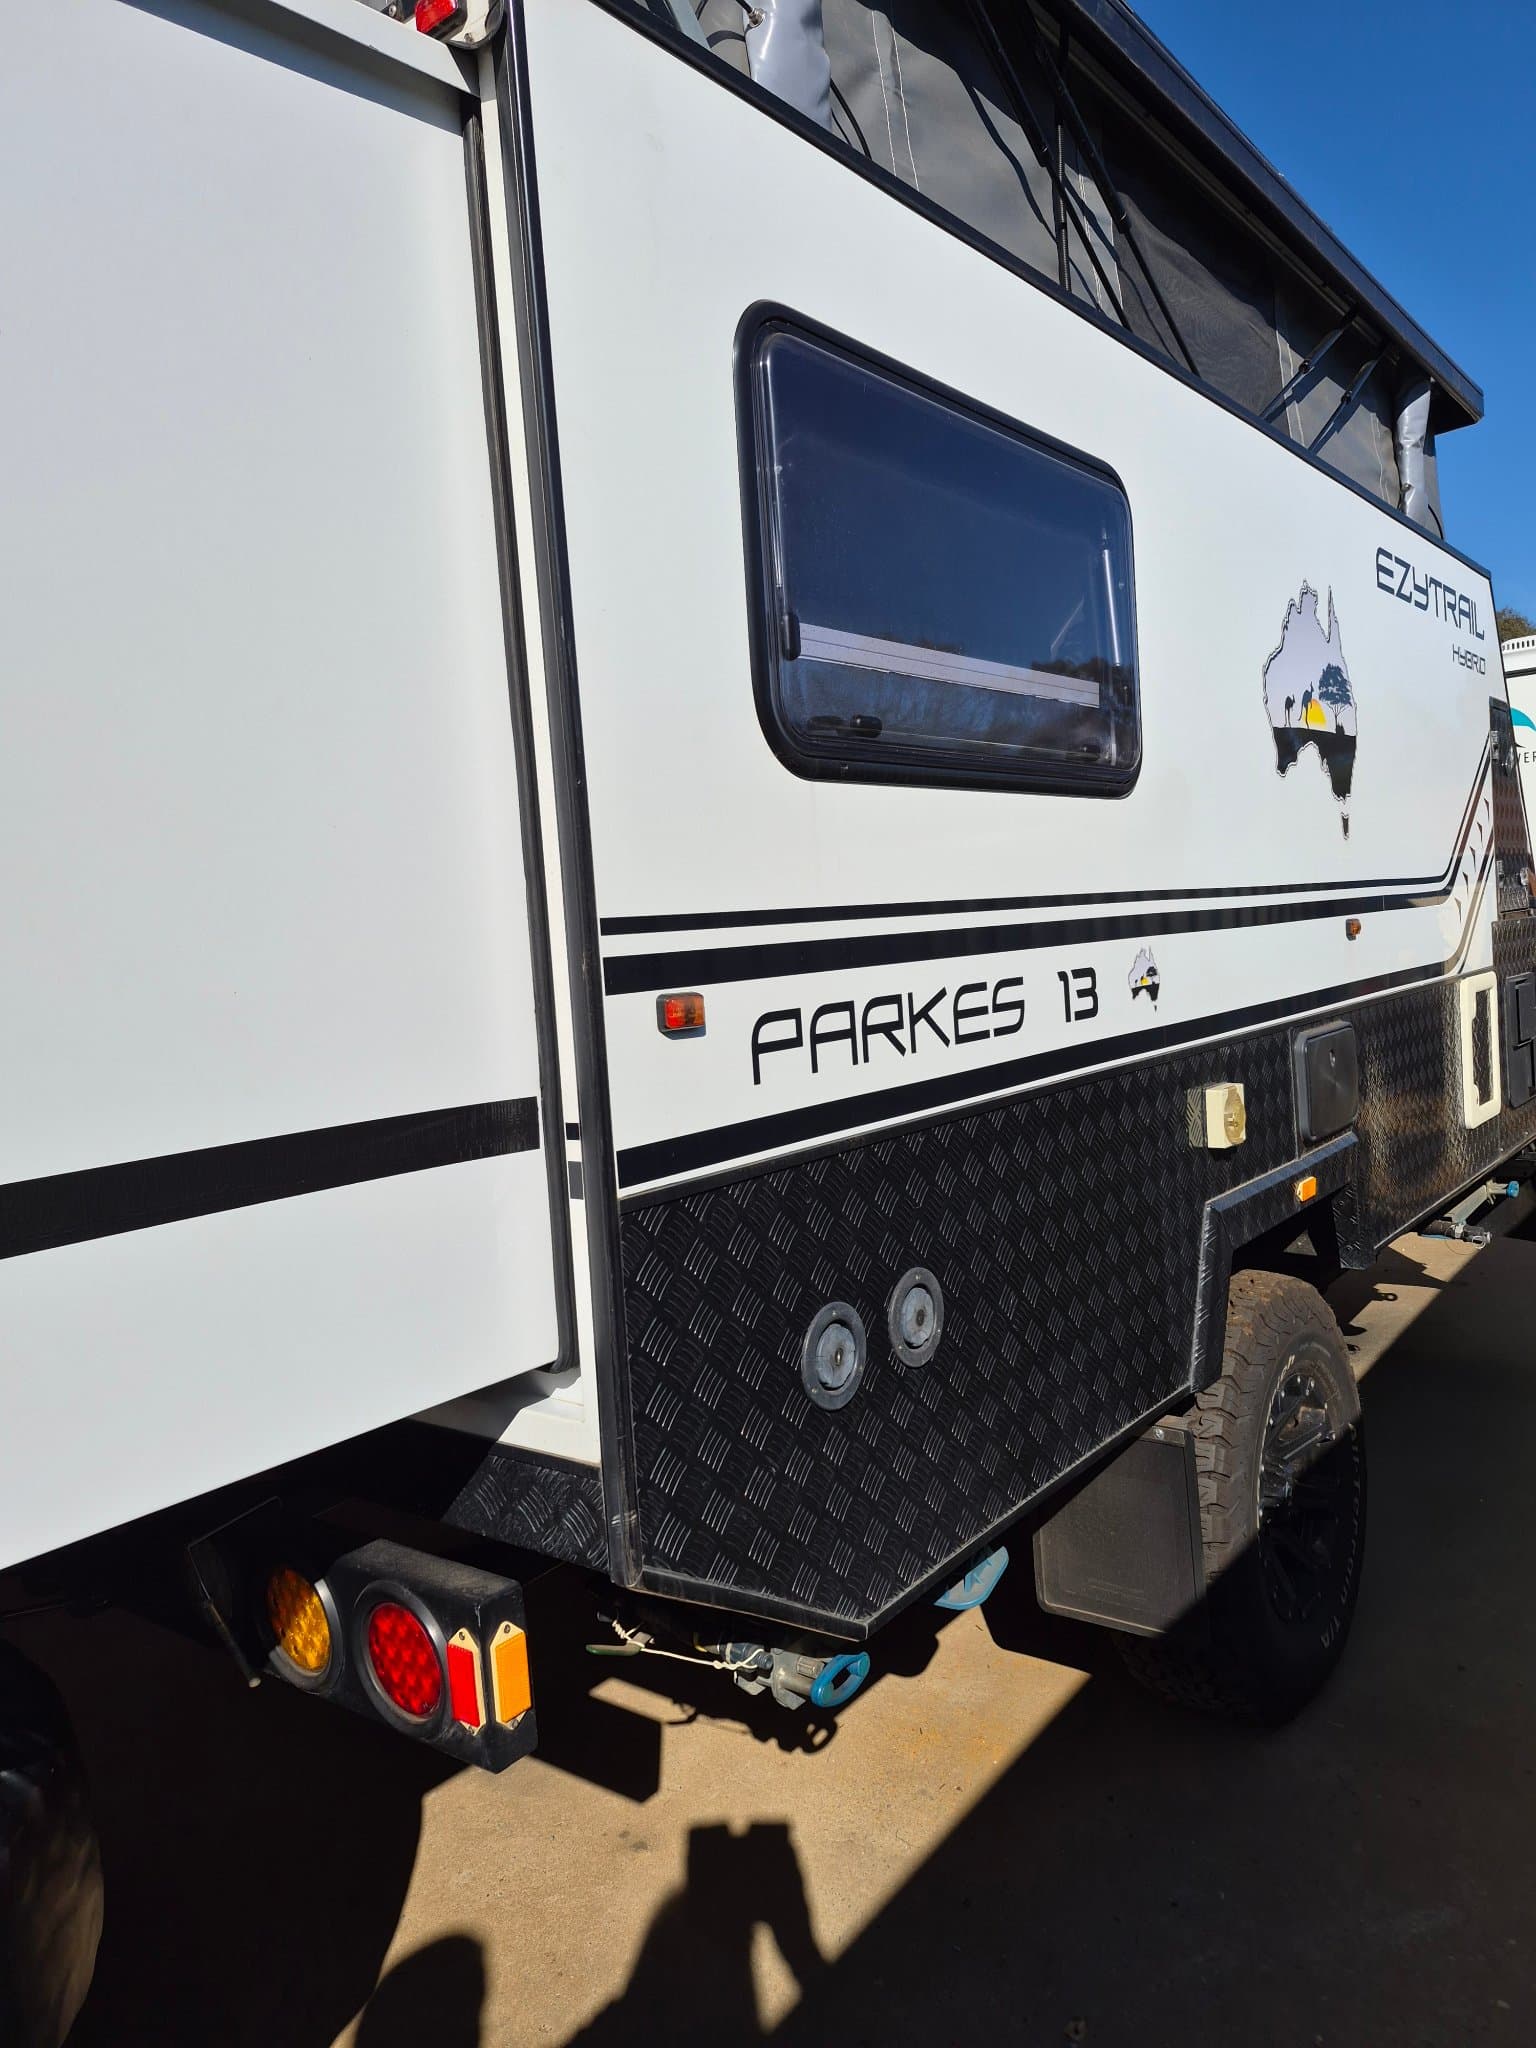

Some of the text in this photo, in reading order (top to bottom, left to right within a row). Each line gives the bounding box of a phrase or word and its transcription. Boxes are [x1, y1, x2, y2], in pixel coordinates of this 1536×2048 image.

[1376, 547, 1485, 641] EZYTRAIL
[1452, 643, 1486, 675] HYBRID
[751, 967, 1099, 1086] PARKES 13
